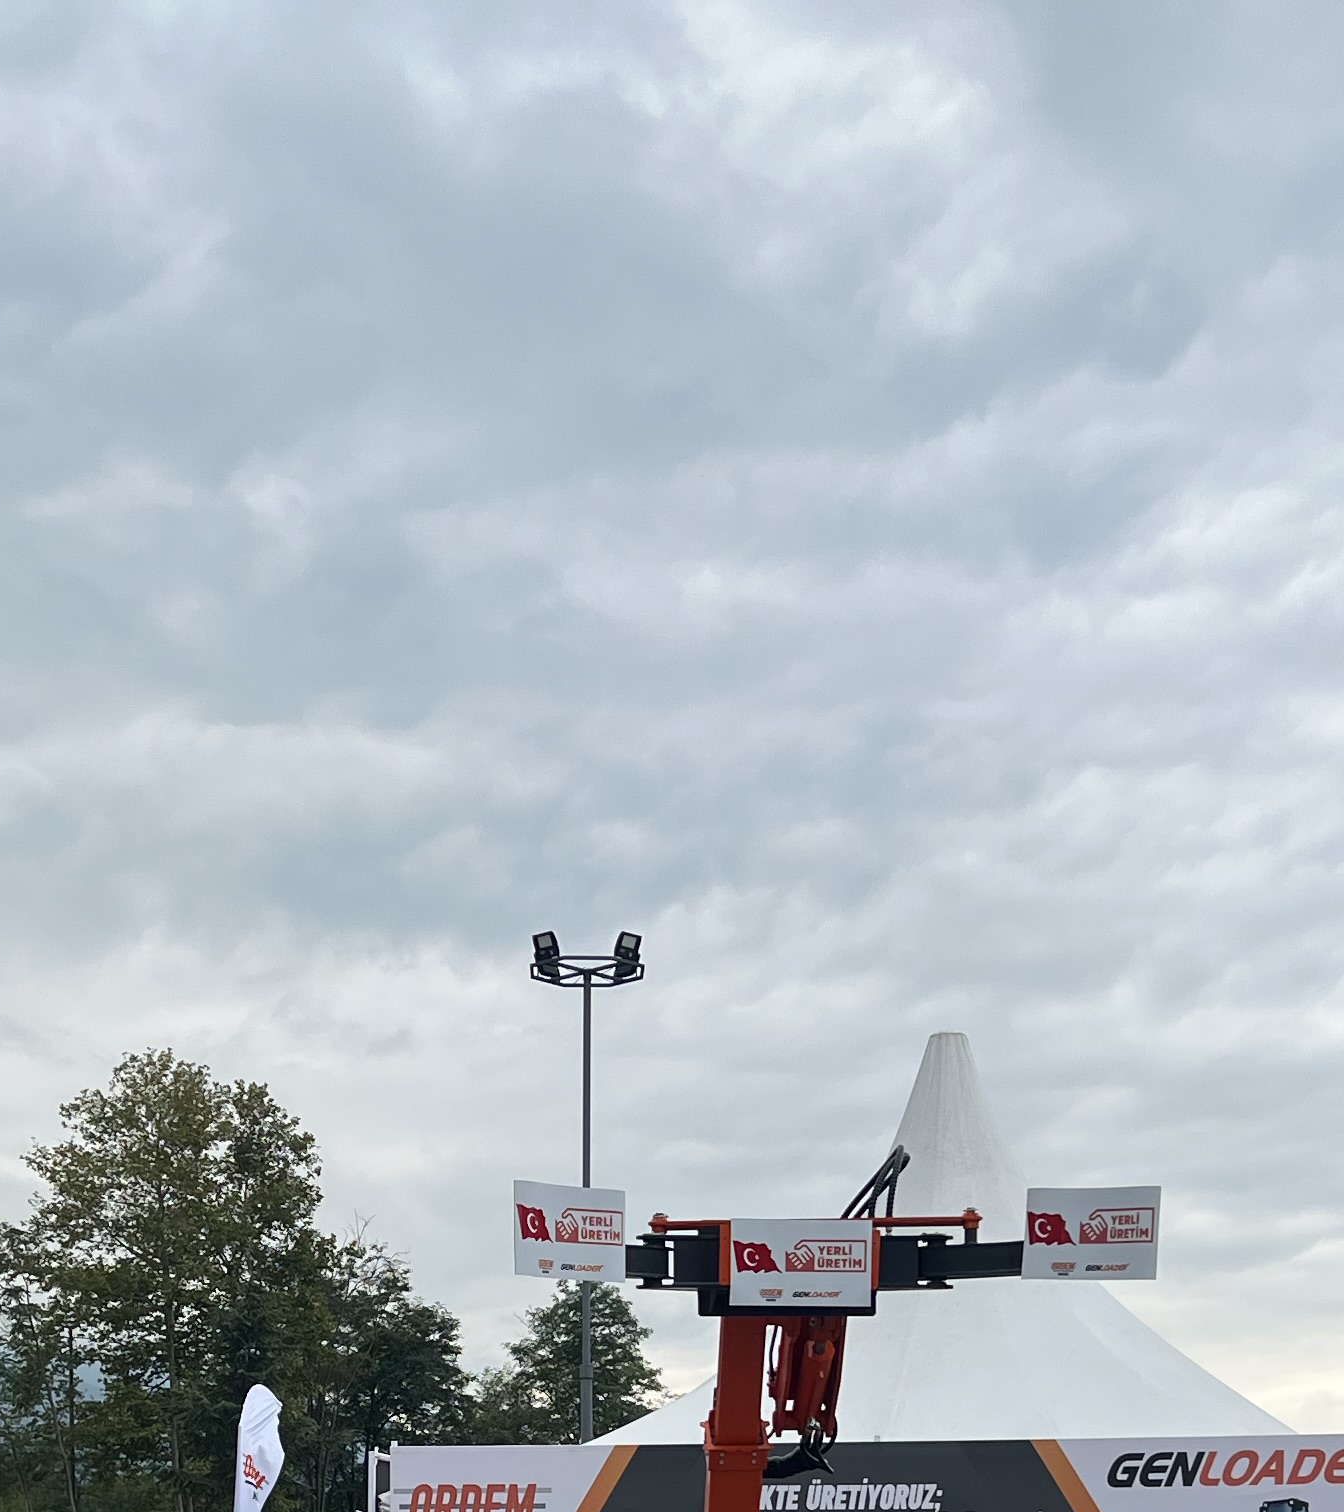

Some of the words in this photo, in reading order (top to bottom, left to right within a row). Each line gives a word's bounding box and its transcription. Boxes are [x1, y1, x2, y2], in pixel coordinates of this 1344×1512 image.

[581, 1214, 613, 1227] YERLİ
[1111, 1212, 1139, 1225] YERLİ
[581, 1227, 620, 1241] ÜRETİM
[1110, 1227, 1148, 1239] ÜRETİM
[818, 1244, 852, 1255] YERLİ
[817, 1258, 862, 1268] ÜRETİM
[806, 1478, 944, 1512] ÜRETİYORUZ;
